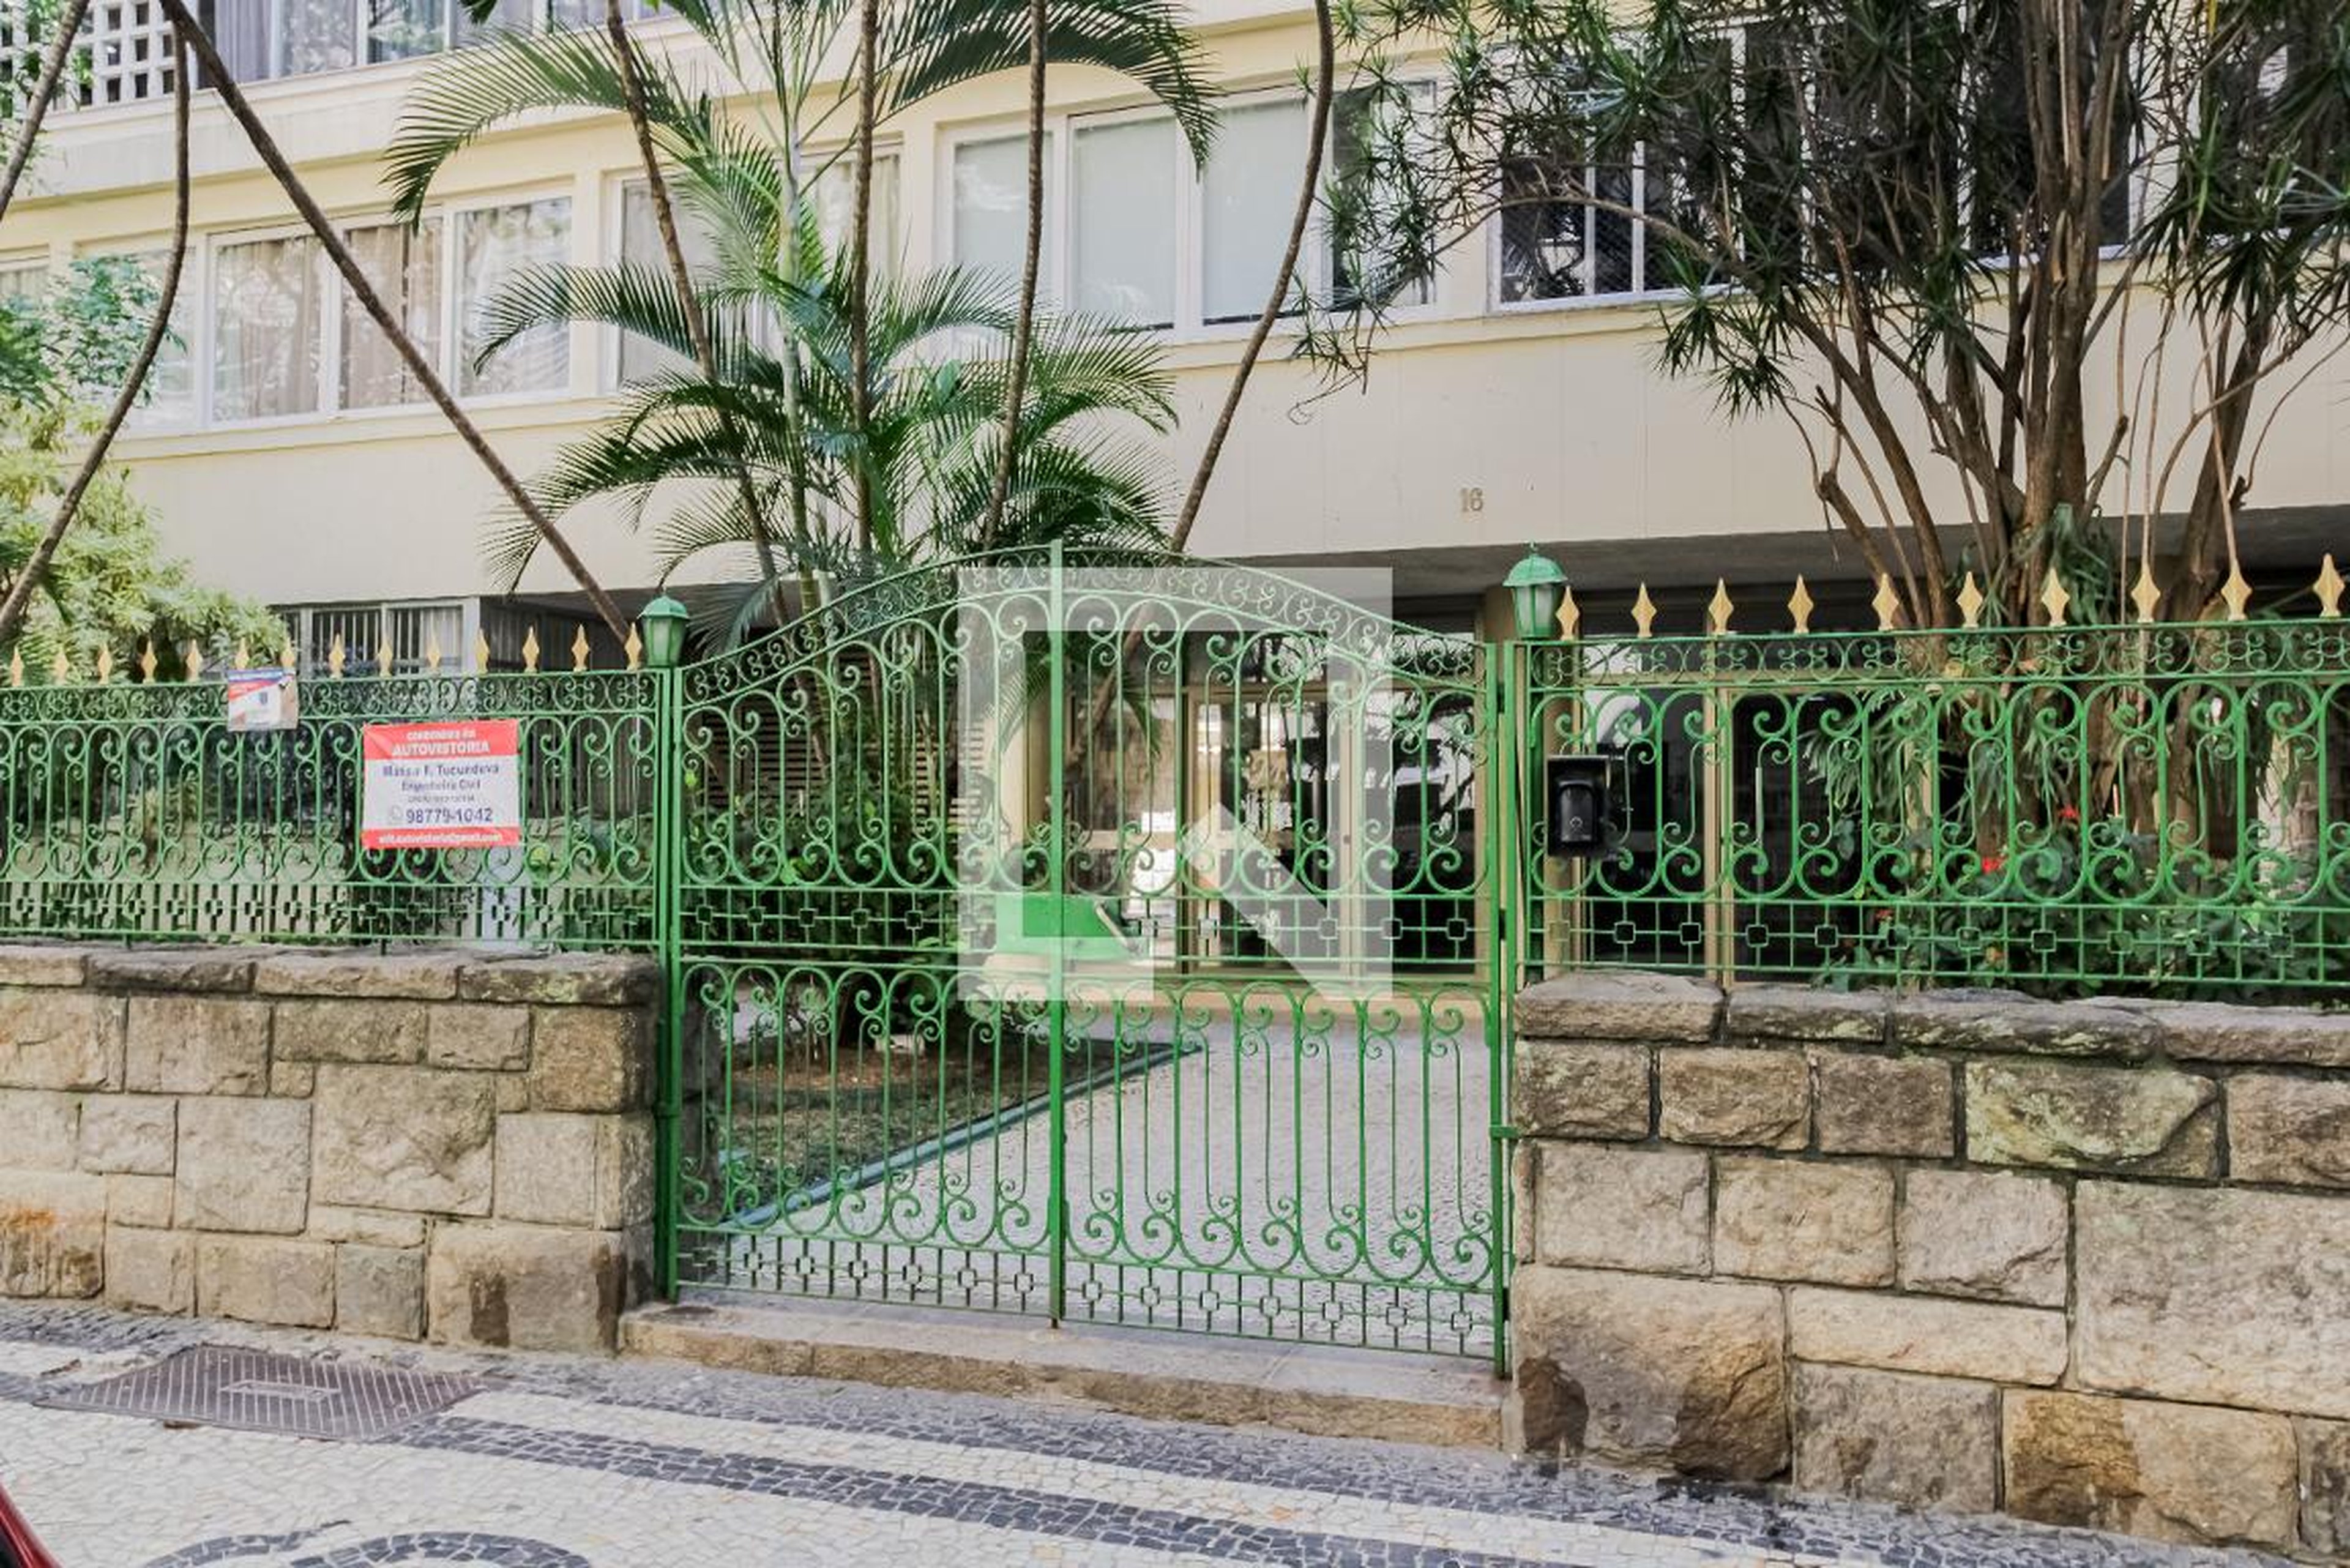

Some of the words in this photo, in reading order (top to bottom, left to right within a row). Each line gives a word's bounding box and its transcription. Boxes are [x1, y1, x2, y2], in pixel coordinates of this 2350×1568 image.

[1457, 487, 1484, 512] 16
[393, 741, 490, 755] AUTOVISTORIA
[406, 808, 493, 823] 98779-1042
